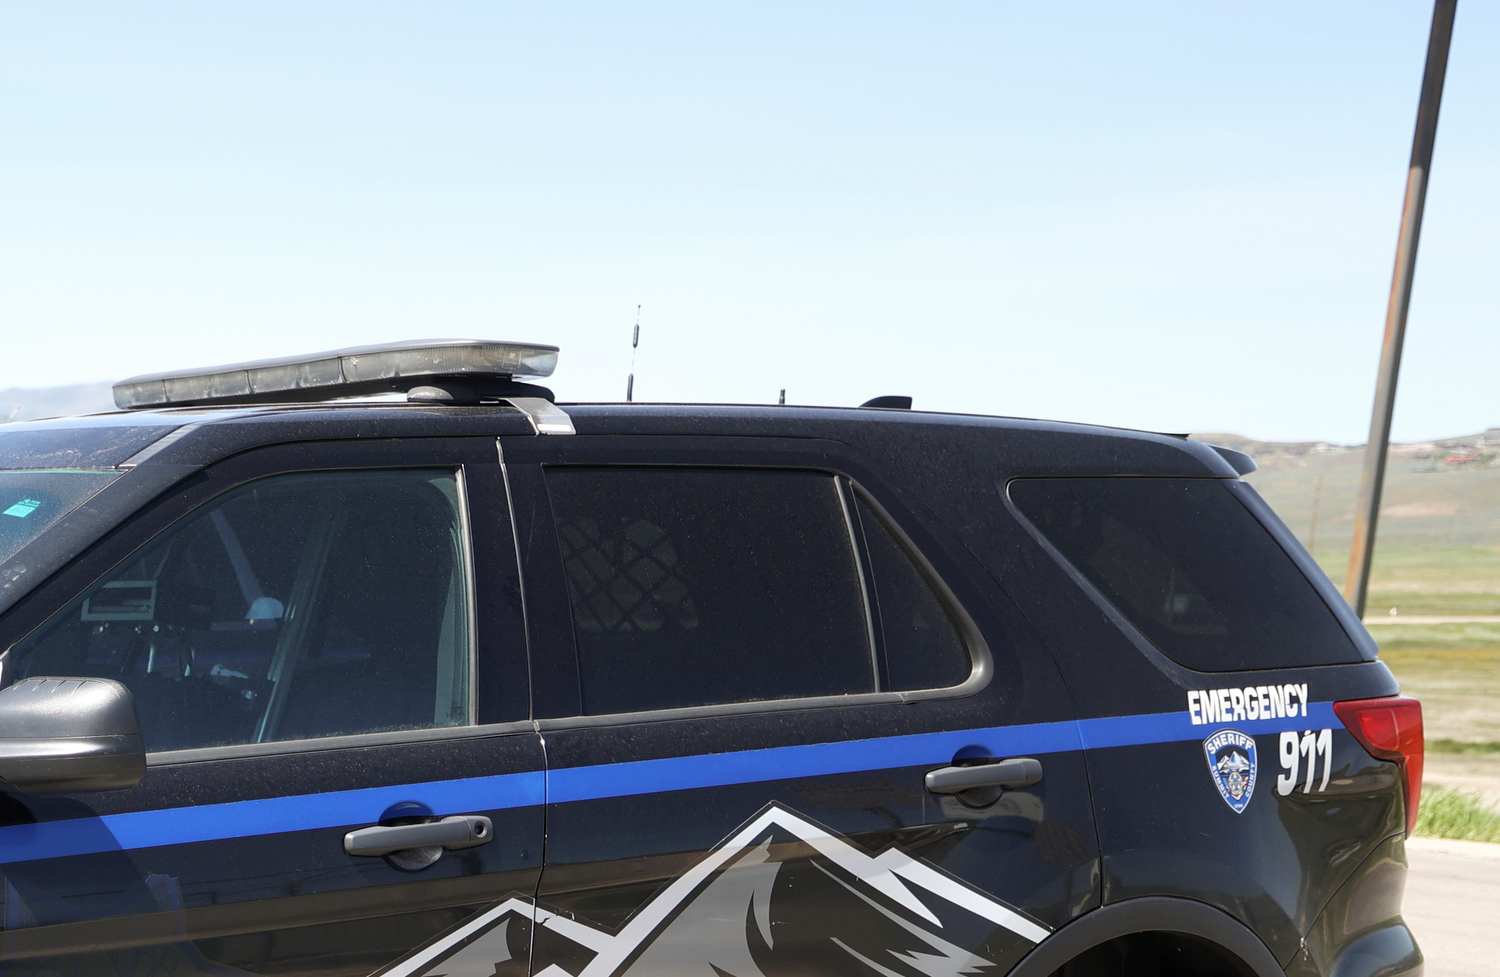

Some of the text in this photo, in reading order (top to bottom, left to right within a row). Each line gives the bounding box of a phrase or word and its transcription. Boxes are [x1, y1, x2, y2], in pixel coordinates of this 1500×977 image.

[1187, 683, 1308, 725] EMERGENCY
[1207, 732, 1253, 755] SHERIFF
[1277, 728, 1333, 796] 911
[1211, 765, 1230, 799] SUMMIT
[1244, 763, 1255, 798] COUNTY
